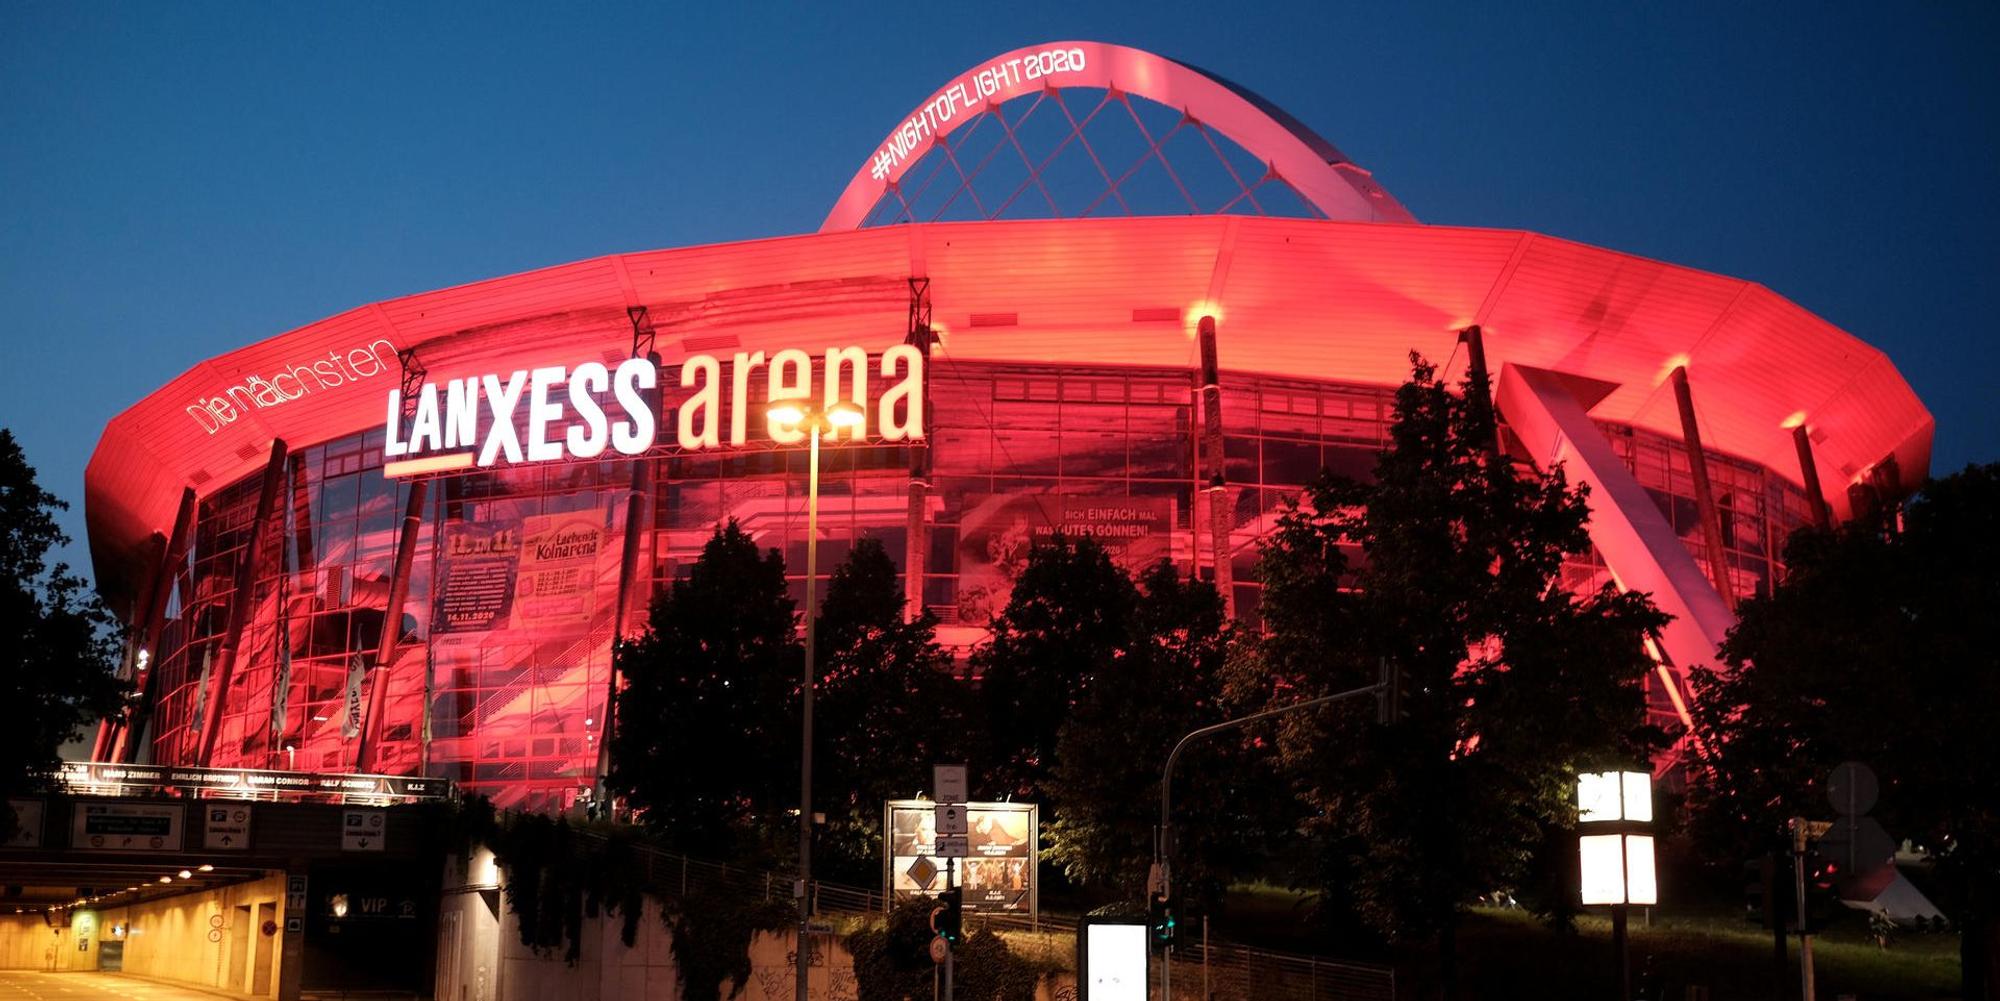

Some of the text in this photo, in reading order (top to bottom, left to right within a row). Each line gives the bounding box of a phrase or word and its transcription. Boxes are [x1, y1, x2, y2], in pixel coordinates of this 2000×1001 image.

[227, 338, 398, 413] nächsten
[383, 344, 925, 467] LANXESS arena
[1065, 508, 1158, 521] SICH EINFACH MAL
[361, 897, 388, 912] VIP
